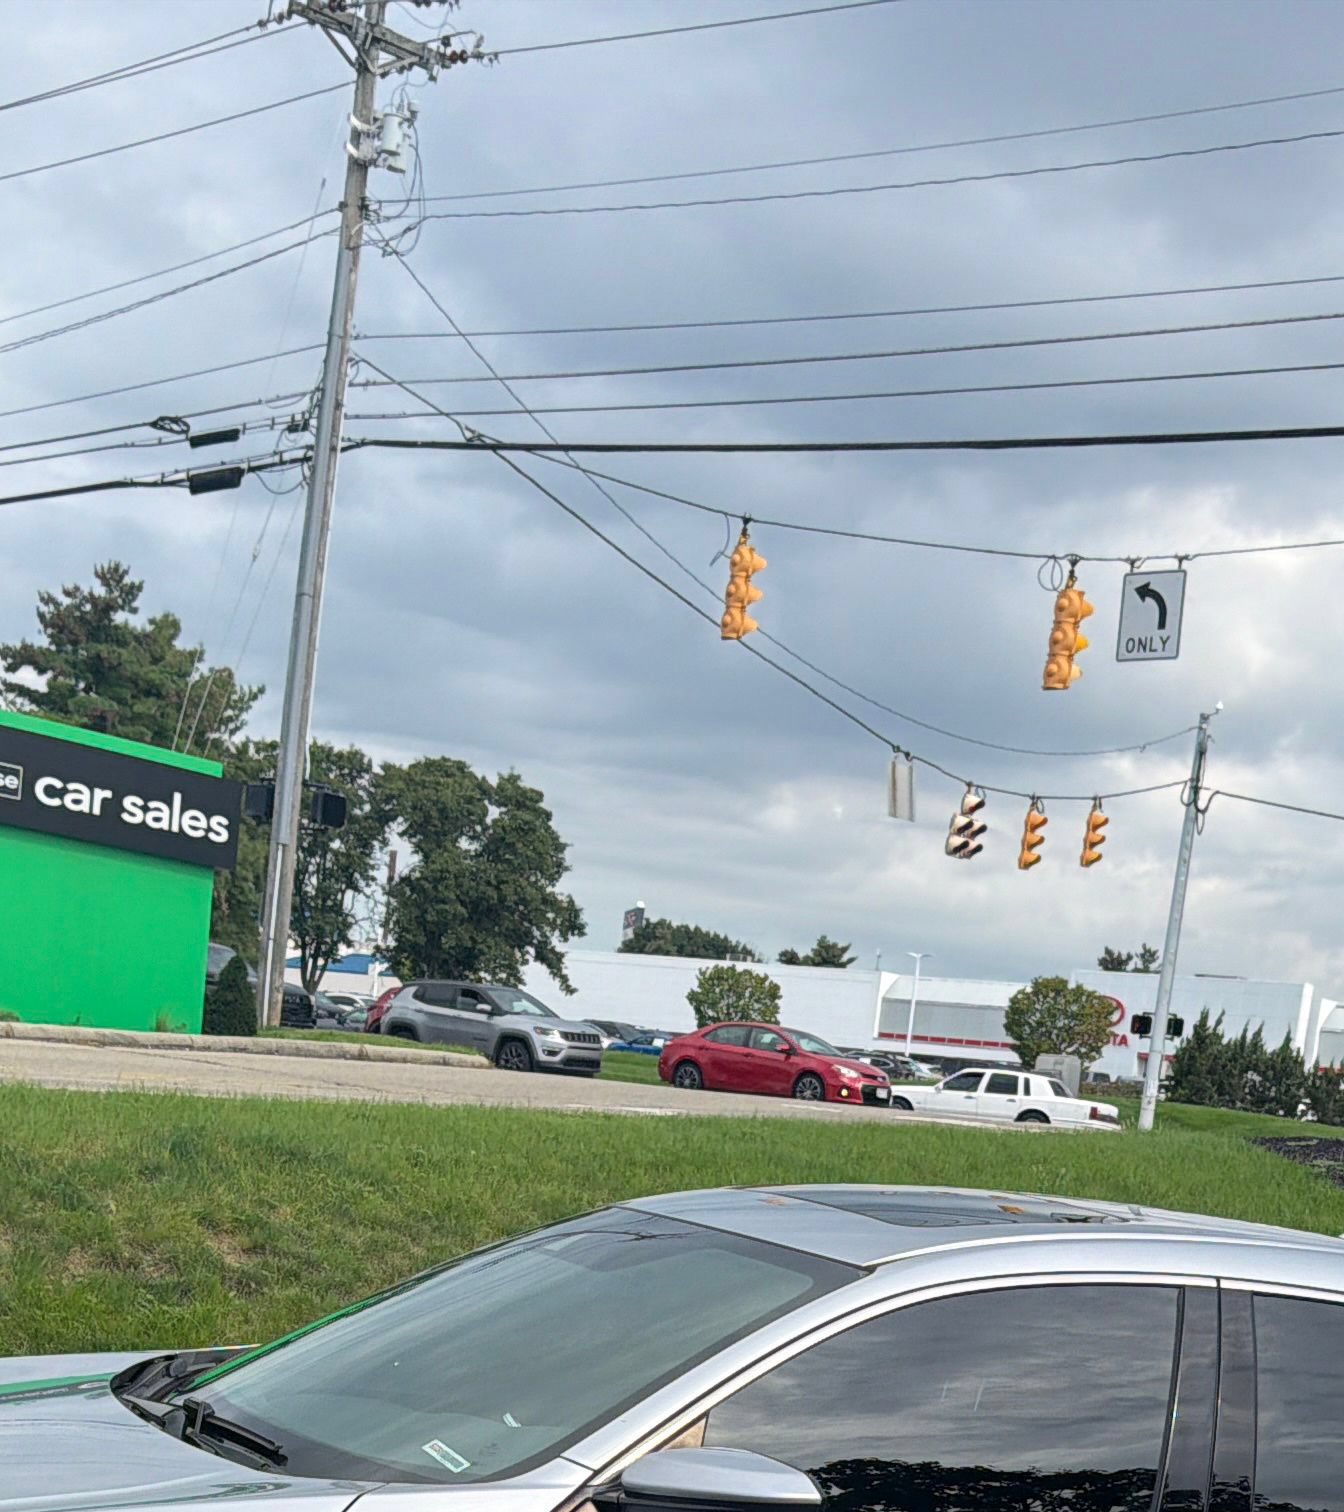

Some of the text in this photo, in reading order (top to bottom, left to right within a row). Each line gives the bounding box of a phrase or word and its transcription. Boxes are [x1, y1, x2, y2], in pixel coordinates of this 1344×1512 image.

[1125, 635, 1170, 654] ONLY
[34, 776, 113, 816] car
[120, 791, 231, 844] sales
